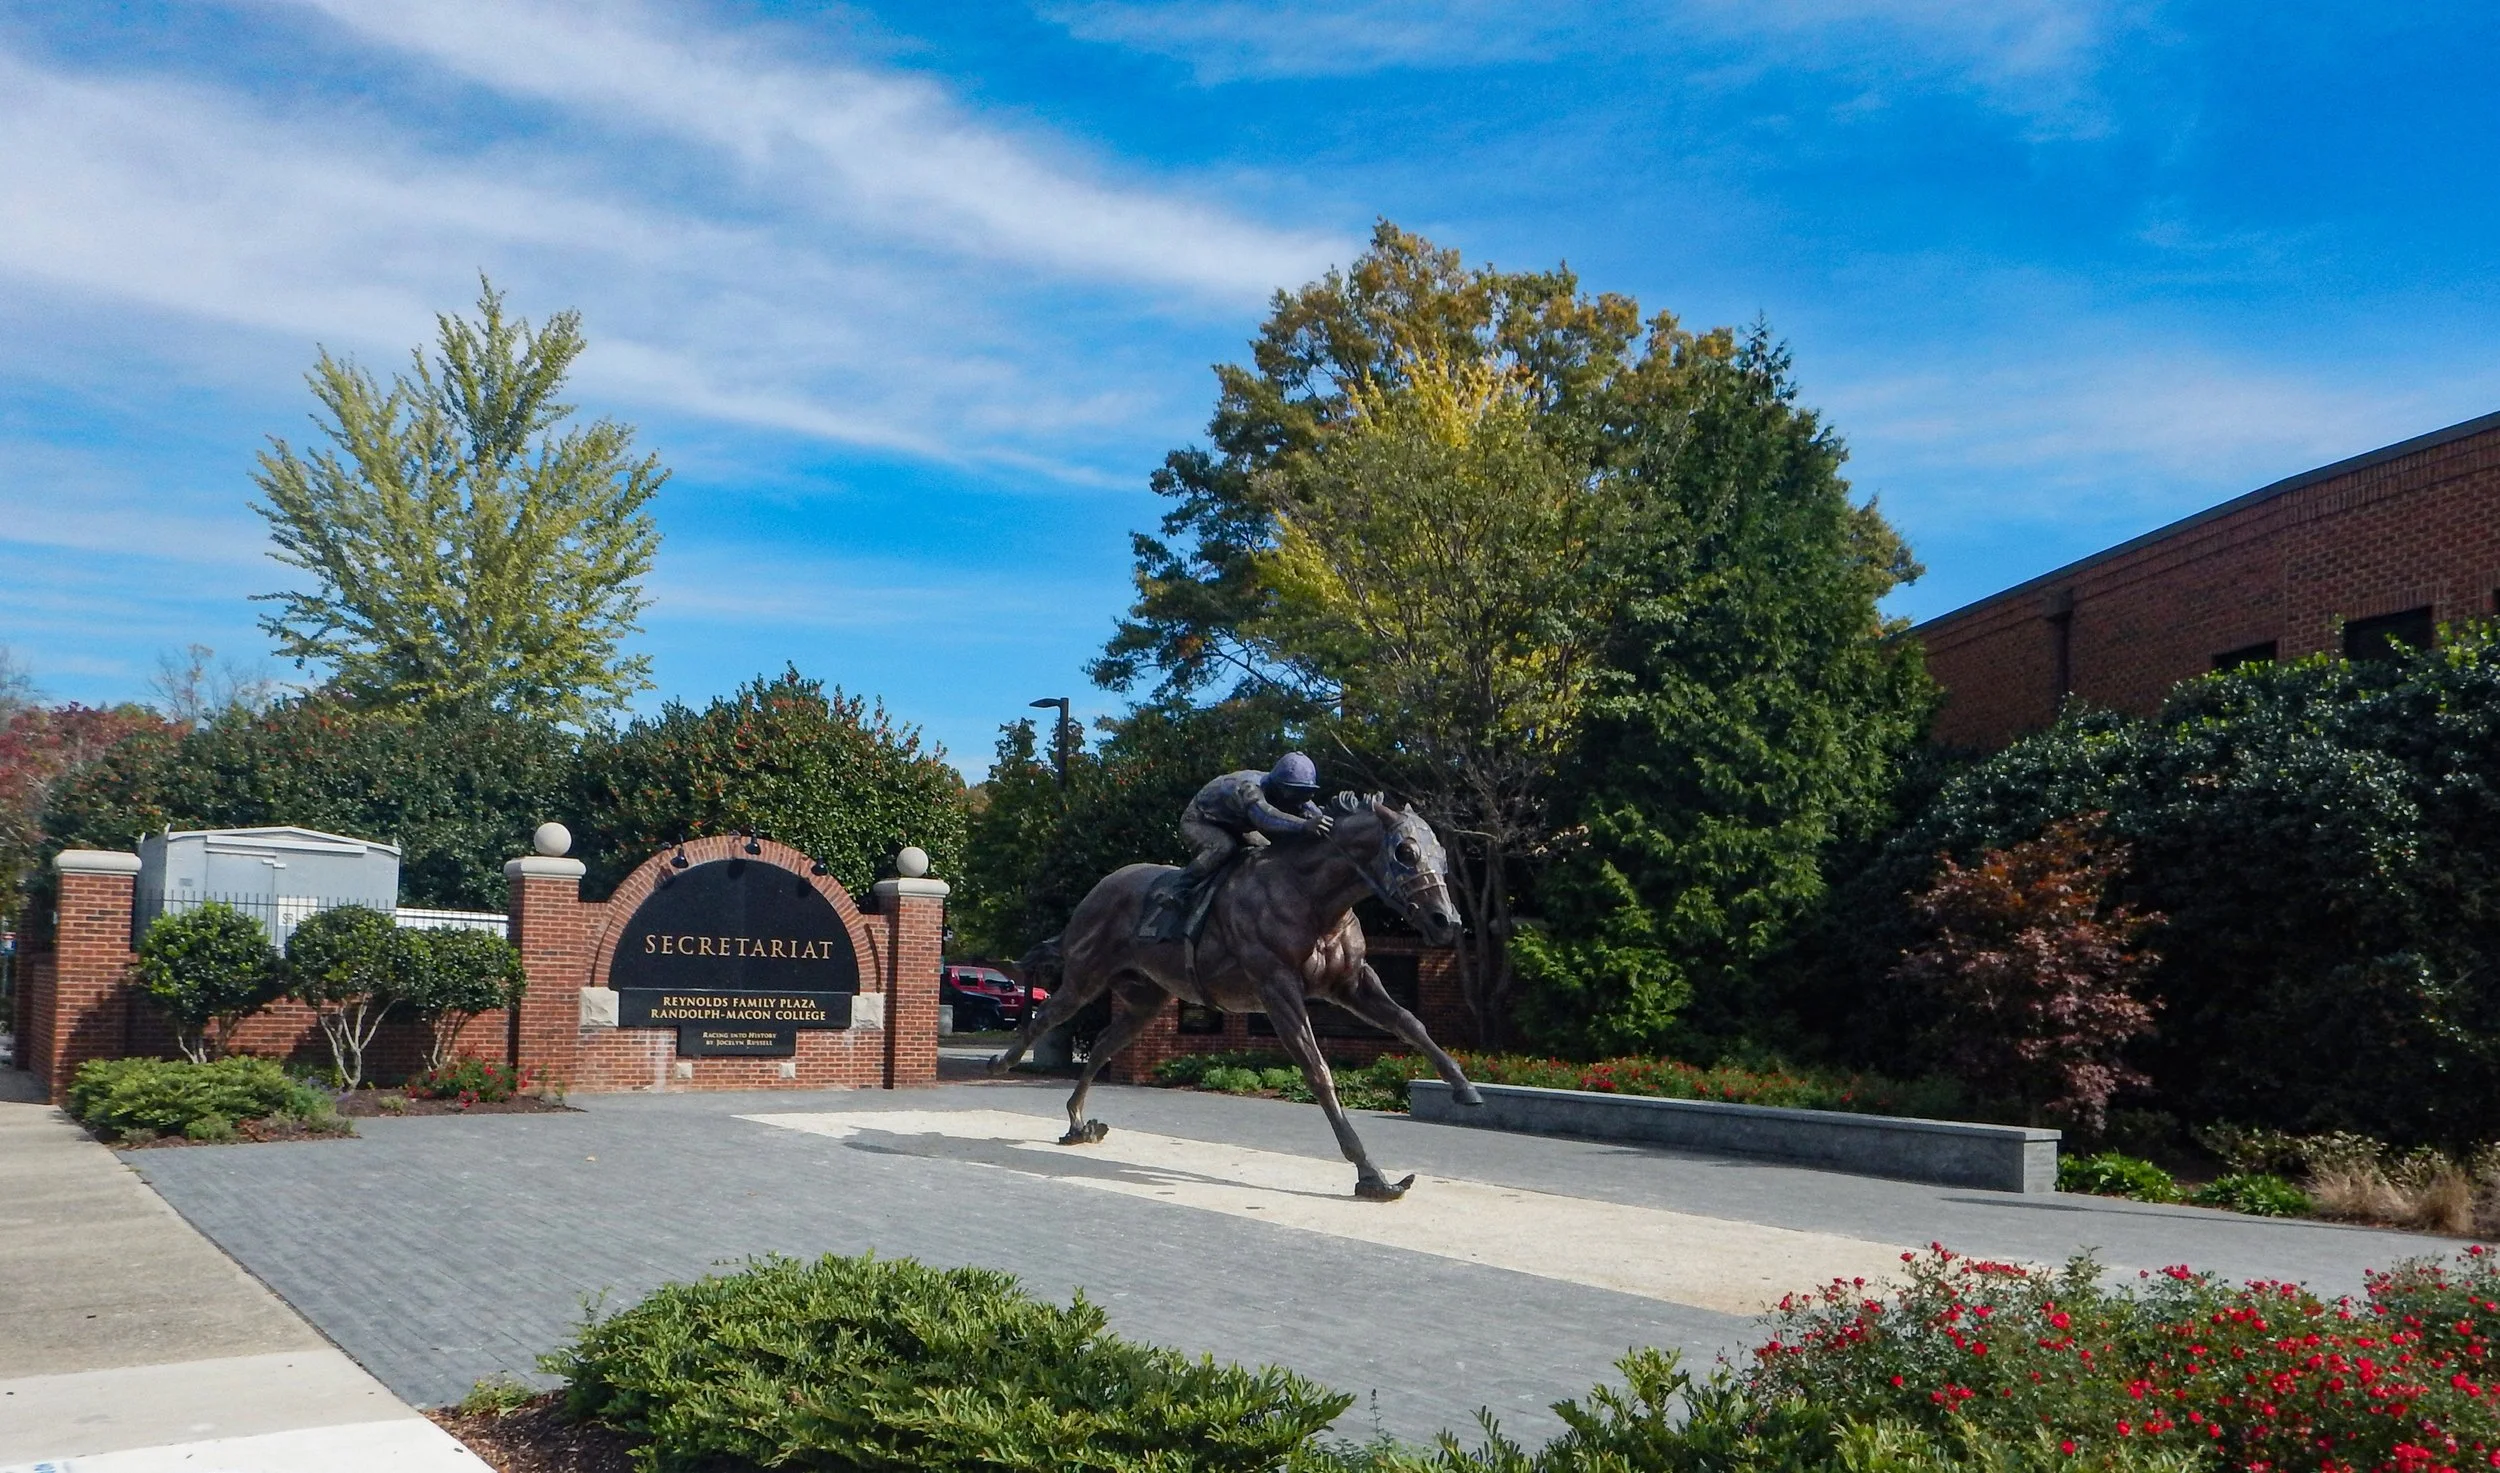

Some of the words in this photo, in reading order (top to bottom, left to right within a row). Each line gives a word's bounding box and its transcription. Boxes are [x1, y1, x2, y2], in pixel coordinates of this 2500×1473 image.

[645, 934, 833, 959] SECRETARIAT
[663, 997, 728, 1007] REYNOLDS
[733, 998, 776, 1008] FAMILY
[780, 999, 816, 1008] PLAZA
[651, 1009, 771, 1020] RANDOLPH-MACON
[775, 1011, 826, 1021] COLLEGE
